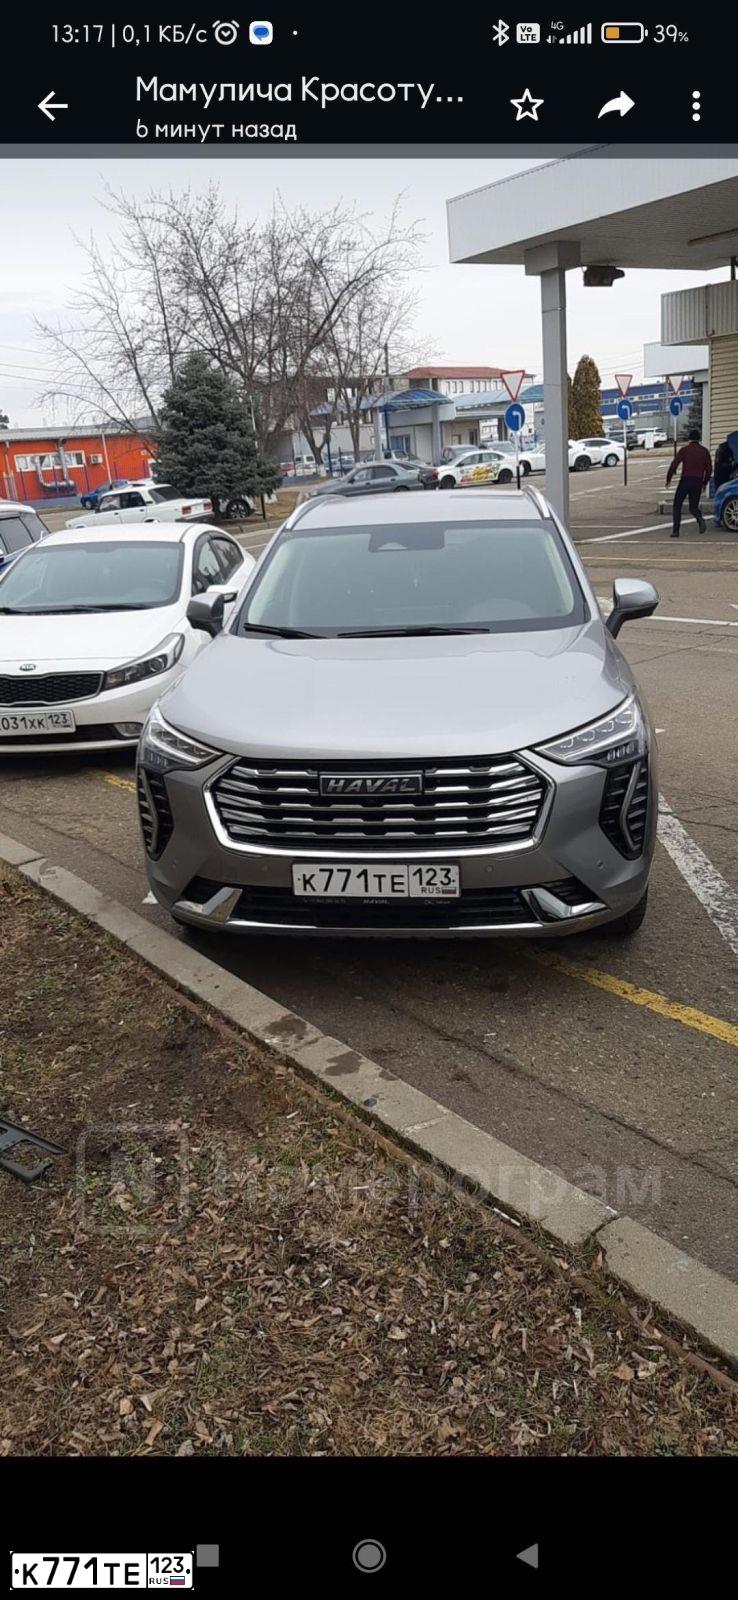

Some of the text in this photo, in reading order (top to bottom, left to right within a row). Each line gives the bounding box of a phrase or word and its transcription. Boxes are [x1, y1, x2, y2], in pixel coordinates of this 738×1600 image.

[0, 713, 68, 731] 031ХК 123
[327, 779, 416, 793] HAVAL
[302, 867, 453, 893] К771ТЕ 123
[421, 886, 441, 894] RUS
